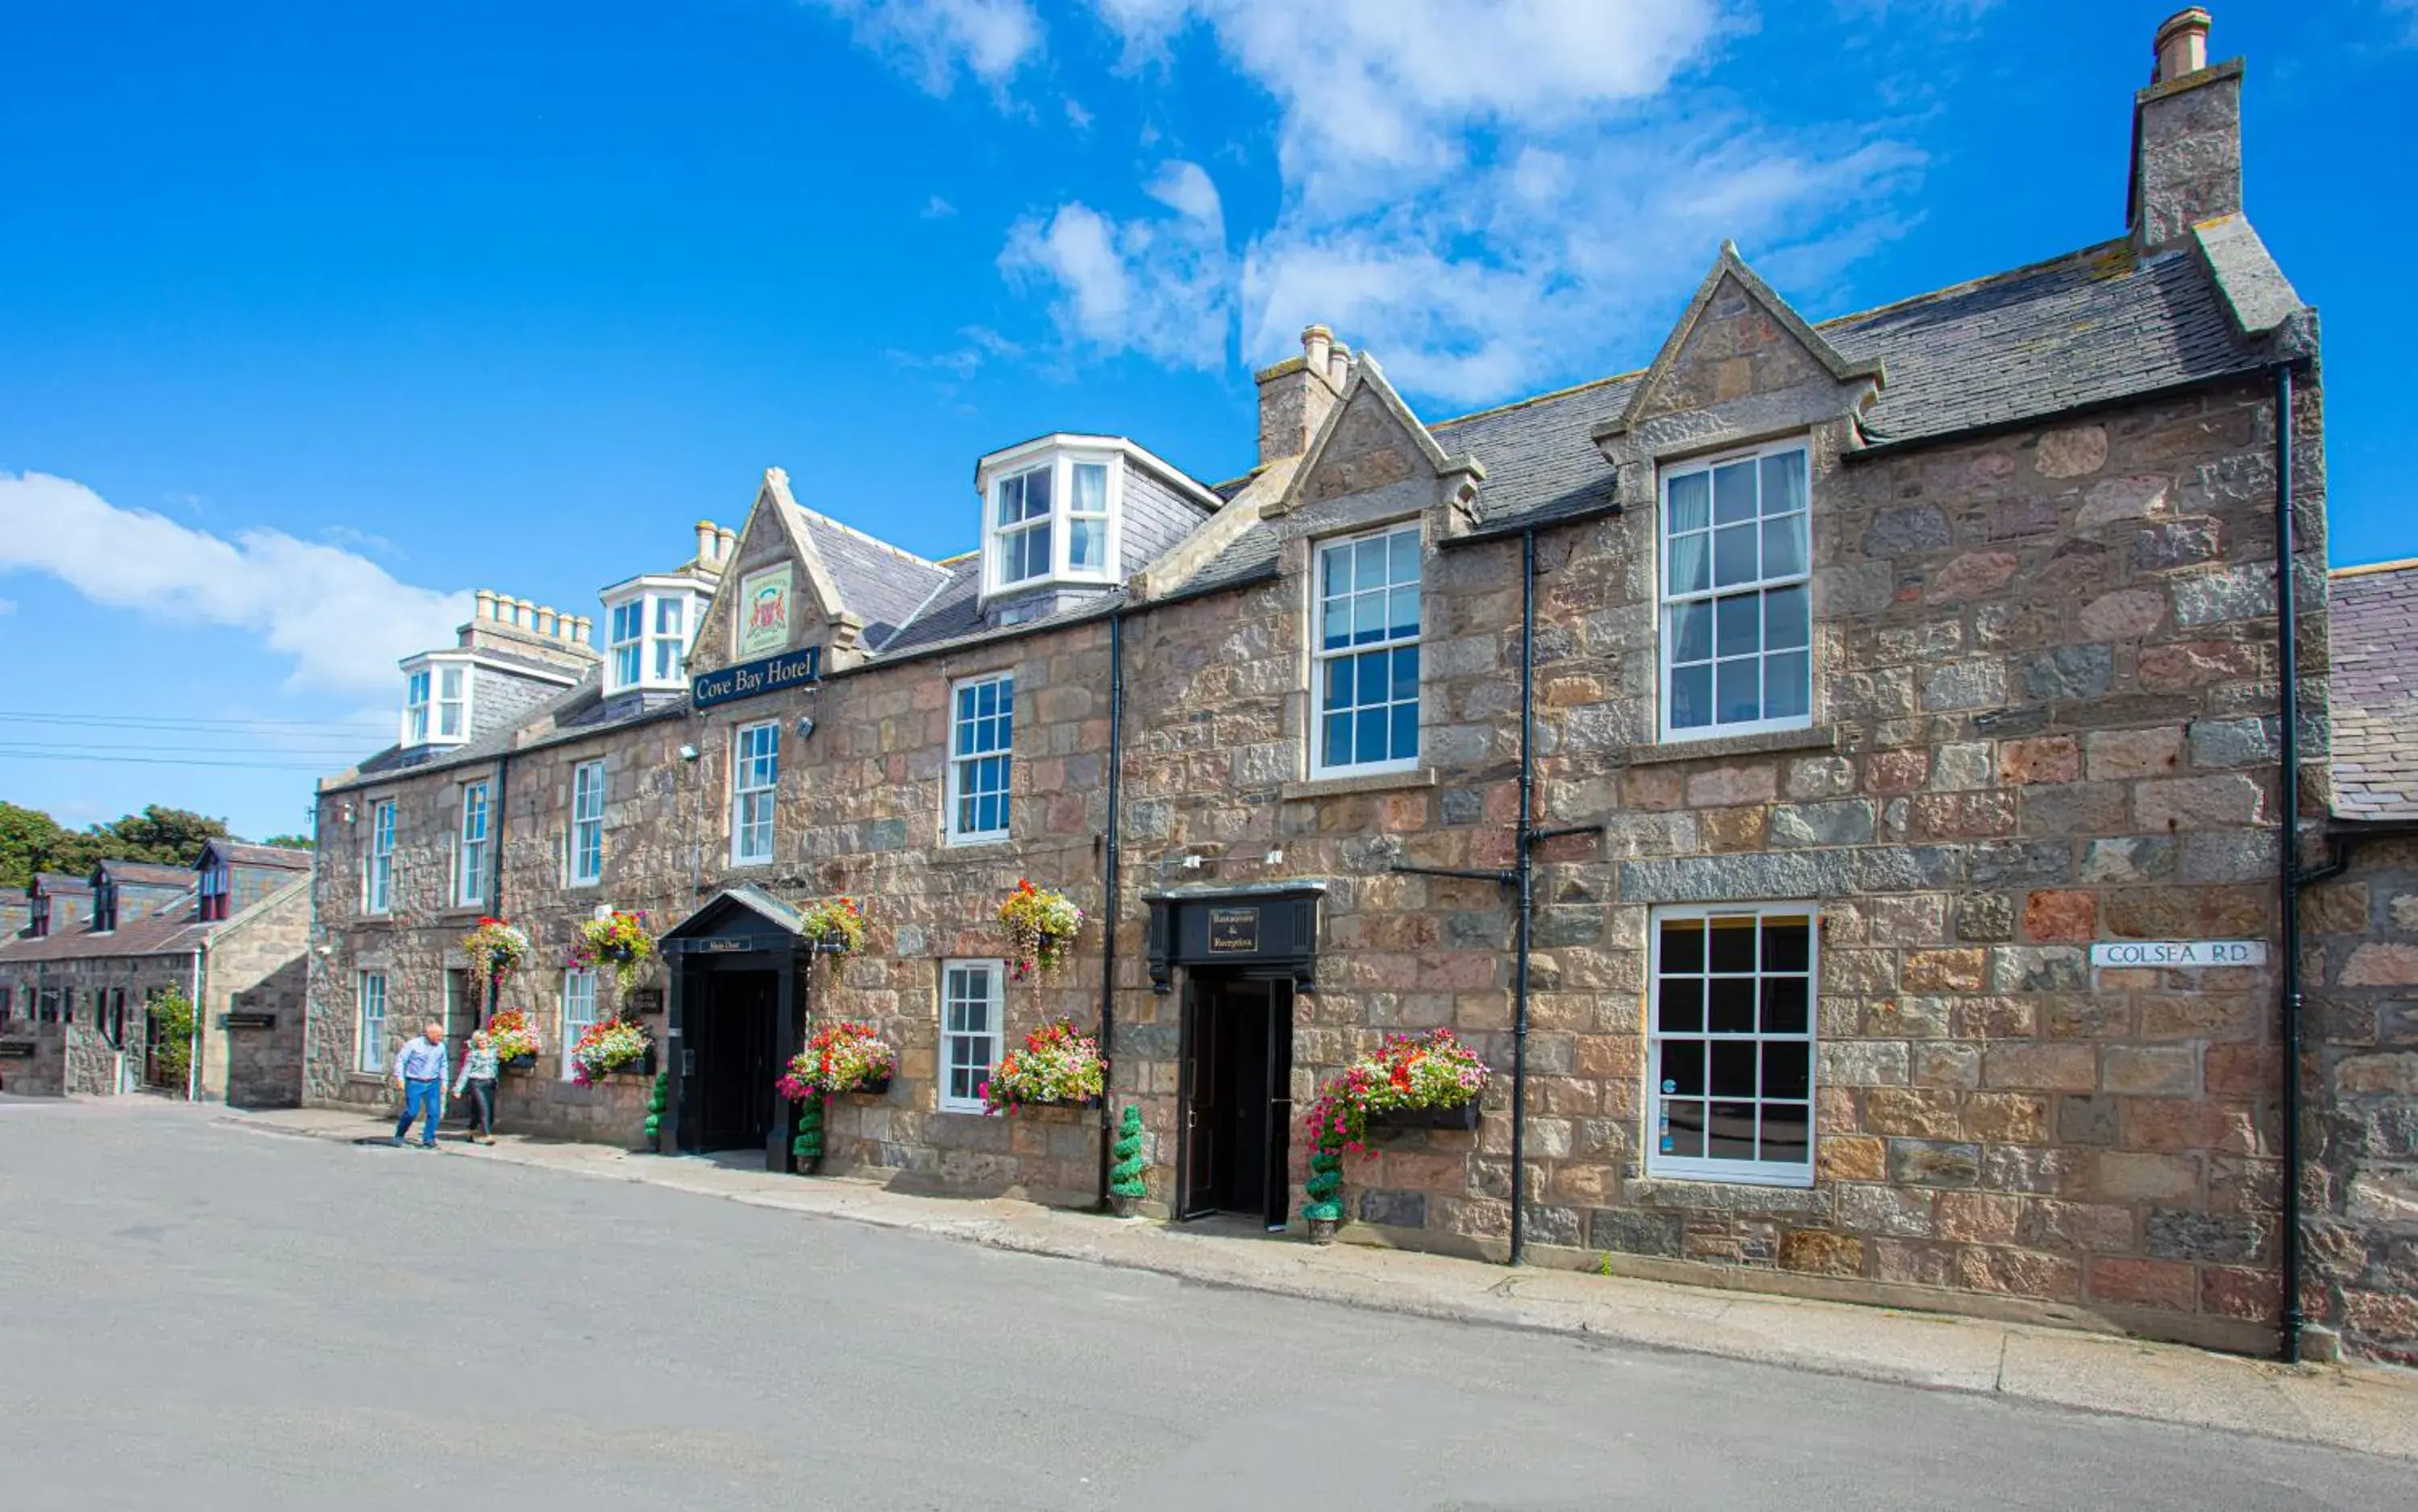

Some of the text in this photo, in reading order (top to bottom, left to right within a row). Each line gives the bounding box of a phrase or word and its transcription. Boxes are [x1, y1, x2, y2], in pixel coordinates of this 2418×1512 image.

[696, 654, 811, 700] Cove Bay Hotel
[2108, 944, 2248, 963] COLSEA RD
